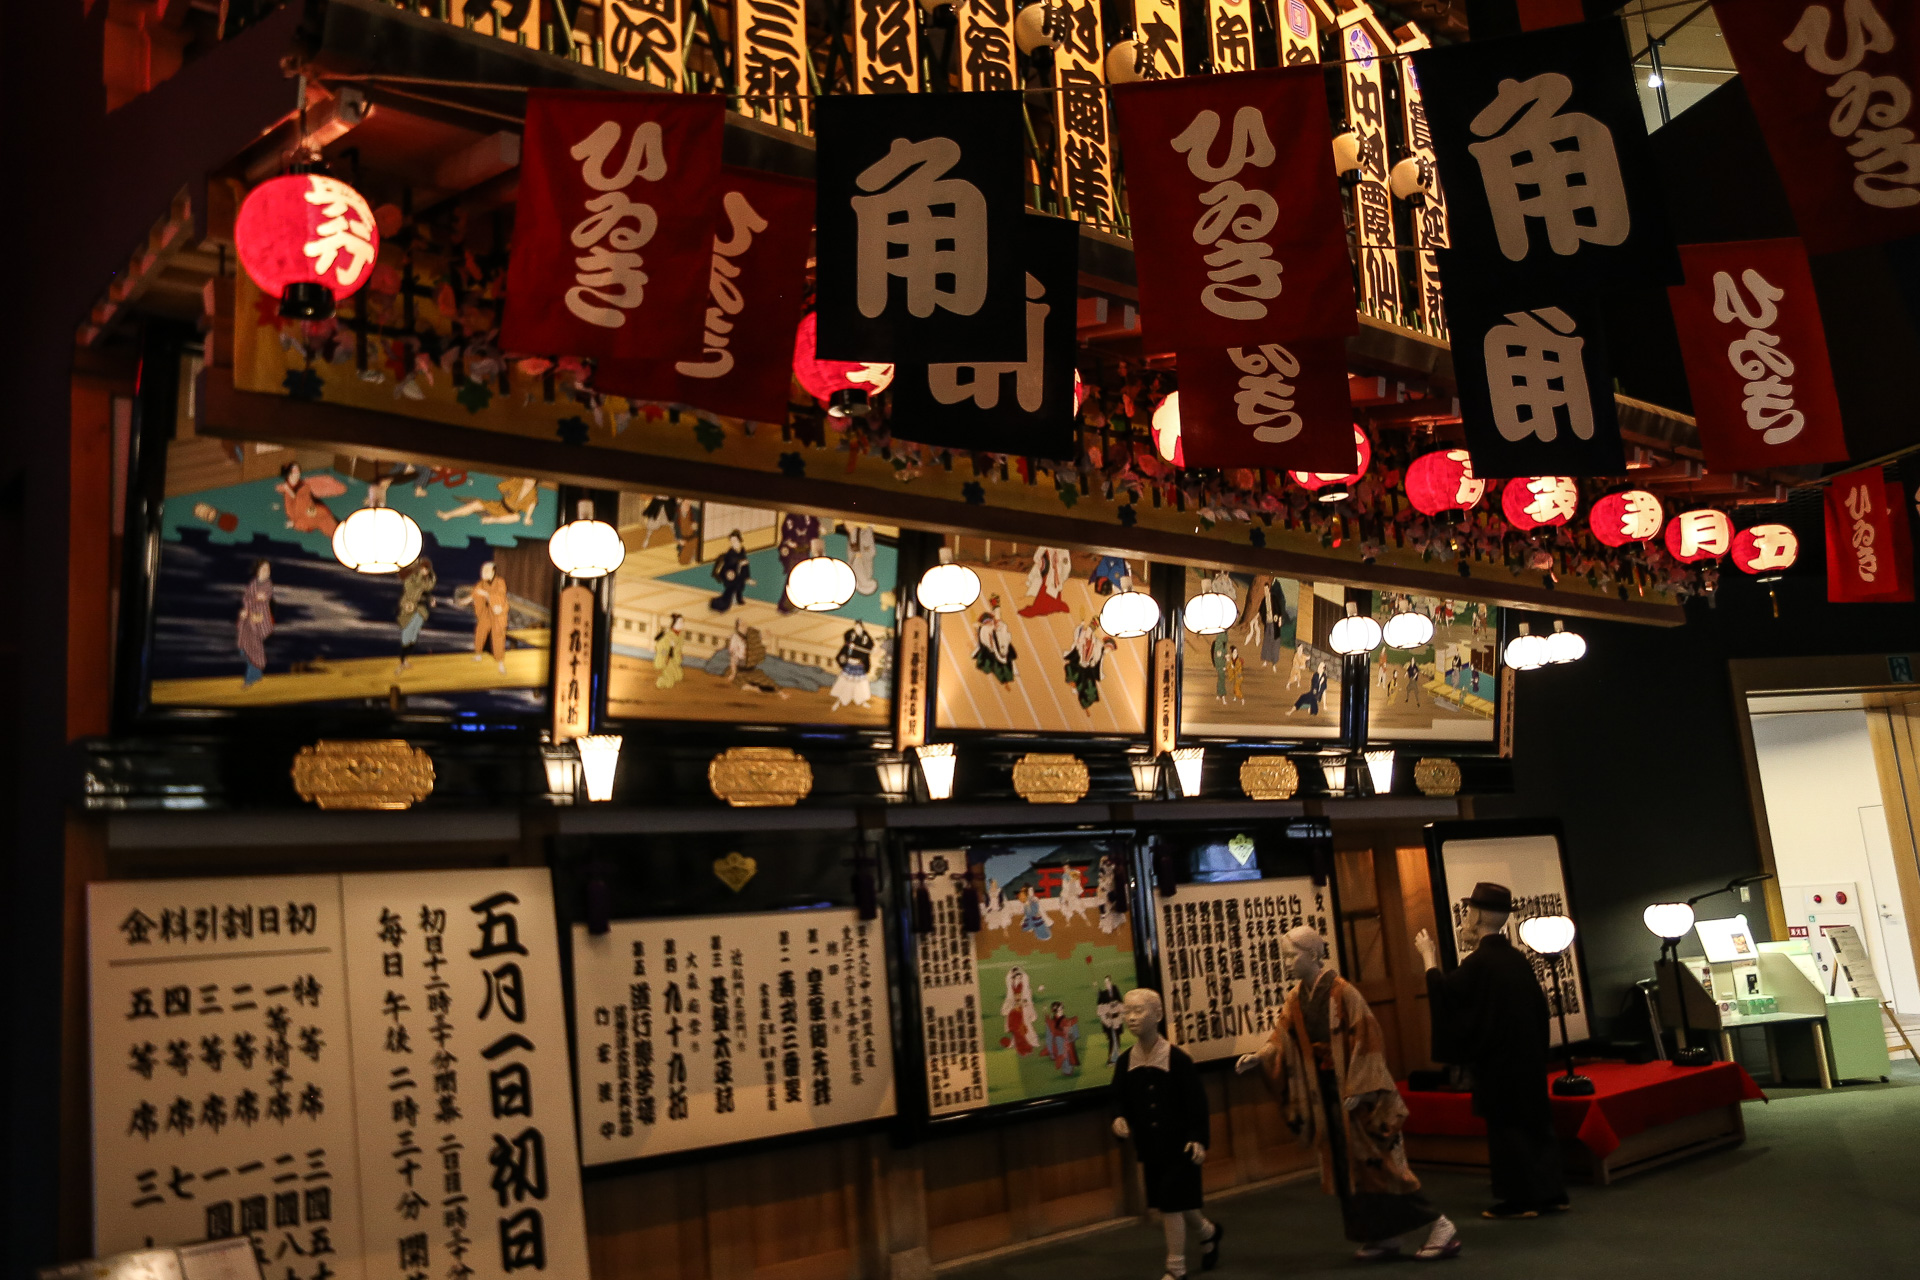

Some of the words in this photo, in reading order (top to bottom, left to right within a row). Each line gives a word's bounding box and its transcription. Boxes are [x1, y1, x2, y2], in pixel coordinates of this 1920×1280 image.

[564, 120, 667, 328] ひゐき
[851, 137, 988, 318] 角
[1170, 106, 1284, 320] ひゐき
[1468, 72, 1630, 262] 角
[1844, 485, 1877, 582] ひゐき
